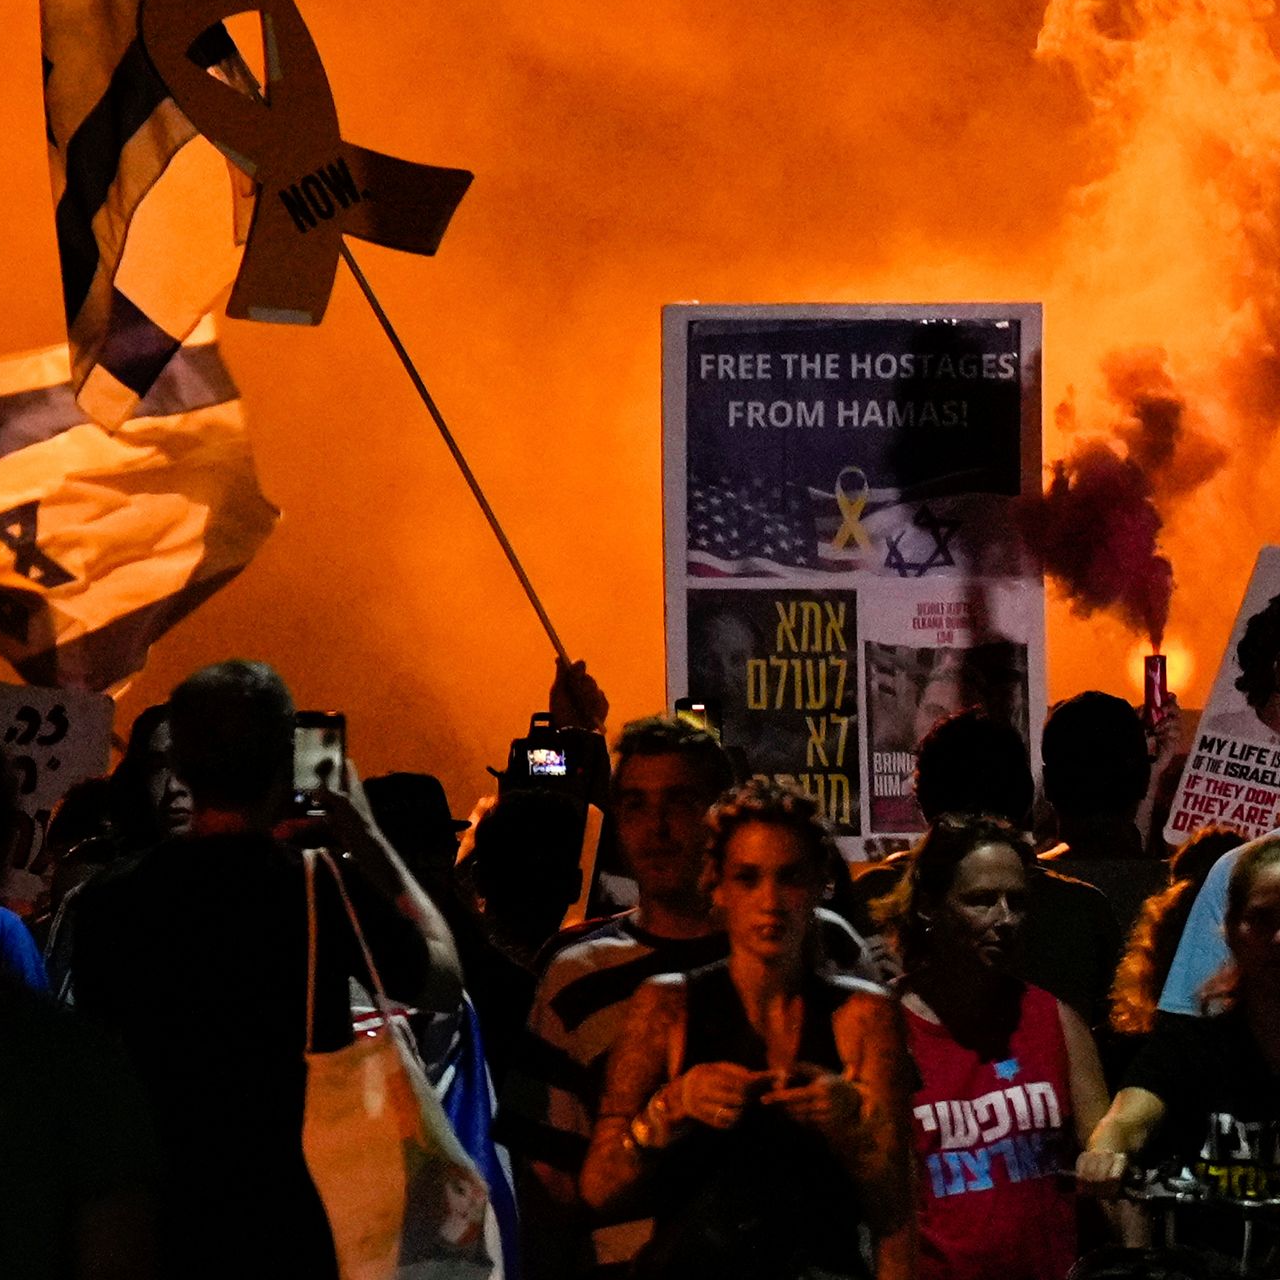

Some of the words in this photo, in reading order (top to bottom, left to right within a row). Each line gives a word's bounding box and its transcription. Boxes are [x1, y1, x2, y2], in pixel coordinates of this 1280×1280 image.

[279, 157, 374, 234] NOW.
[700, 353, 772, 380] FREE
[781, 353, 841, 380] THE
[851, 352, 1016, 380] HOSTAGES
[728, 400, 826, 428] FROM
[837, 400, 970, 428] HAMAS!
[775, 601, 848, 653] אמא
[746, 654, 849, 710] לעולם
[805, 713, 850, 768] לא
[1199, 735, 1228, 755] MY
[1229, 741, 1270, 765] LIFE
[1192, 755, 1206, 770] OF
[1205, 757, 1223, 775] THE
[1185, 773, 1203, 790] IF
[1205, 778, 1245, 799] THEY
[1182, 791, 1230, 816] THEY
[1230, 803, 1272, 827] ARE
[912, 1080, 1062, 1150] חופשי
